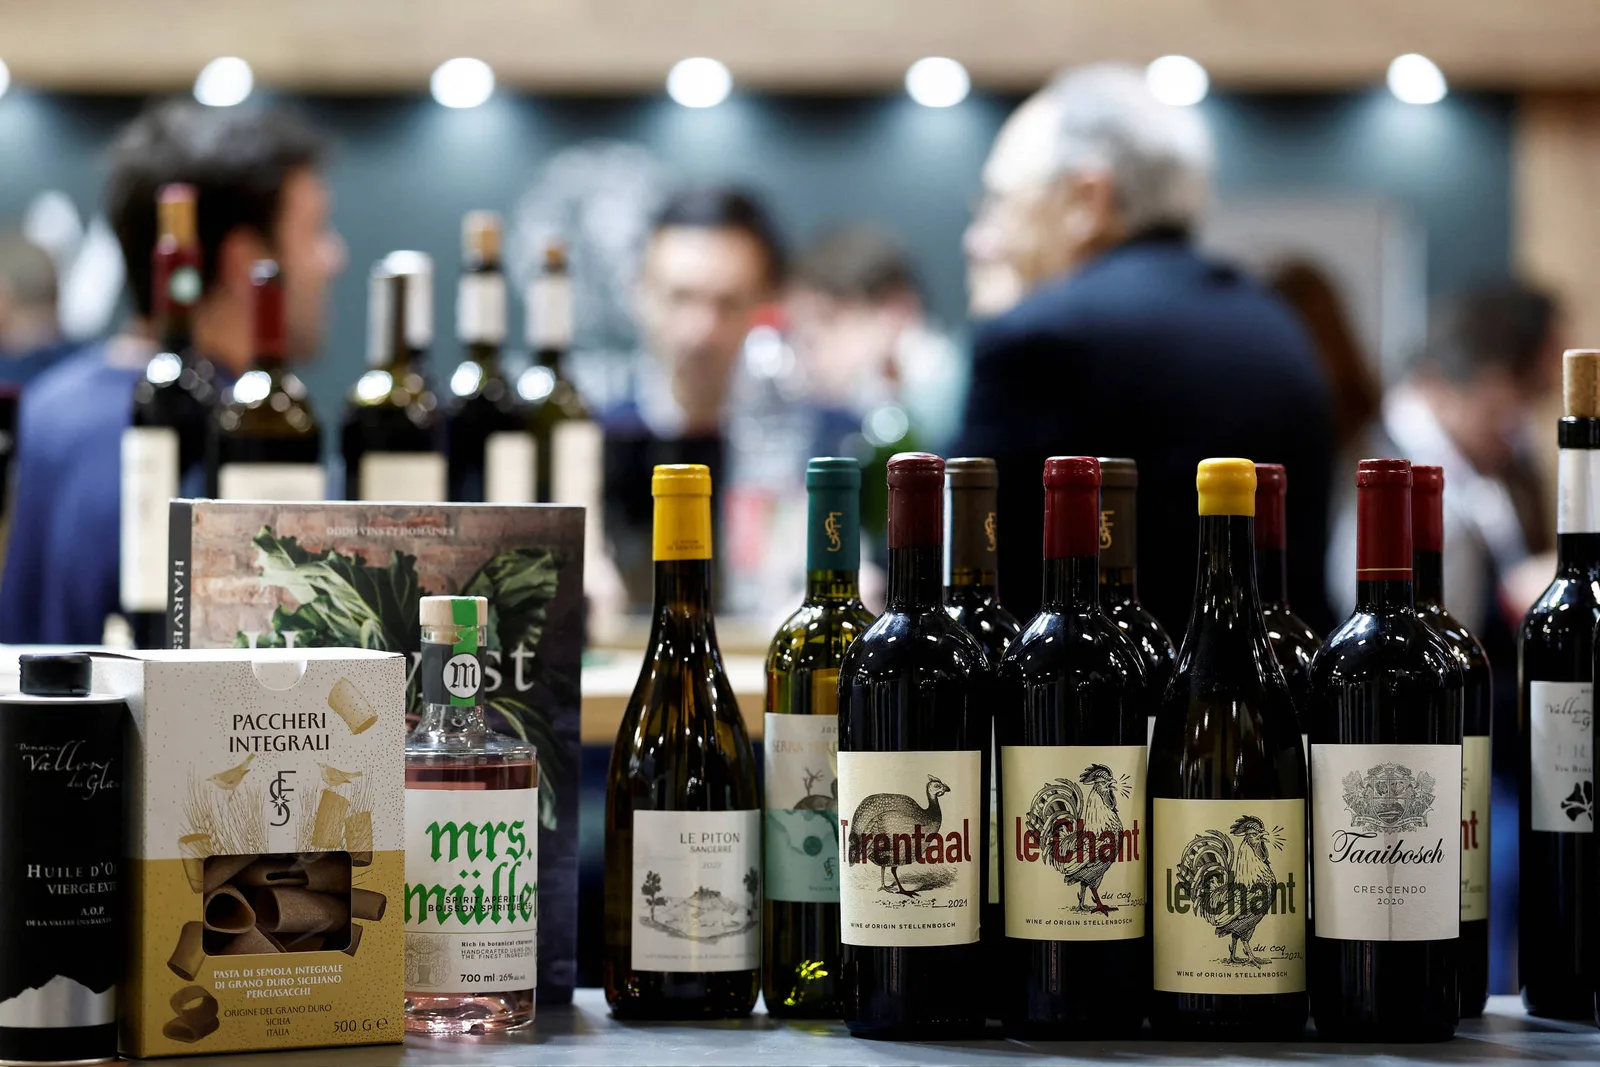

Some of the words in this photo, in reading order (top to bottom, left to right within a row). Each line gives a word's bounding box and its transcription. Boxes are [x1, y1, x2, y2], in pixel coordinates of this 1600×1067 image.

[326, 526, 358, 536] ODDO
[233, 712, 326, 730] PACCHERI
[229, 734, 329, 752] INTEGRALI
[425, 820, 532, 862] mrs.
[680, 833, 696, 844] LE
[701, 832, 741, 843] PITON
[841, 819, 971, 865] Tarentaal
[1015, 817, 1041, 862] le
[1052, 817, 1140, 863] Chant
[690, 845, 732, 854] SANCERRE
[1329, 829, 1445, 865] Taaibosch
[27, 864, 83, 878] HUILE
[47, 883, 96, 895] VIERGE
[1166, 868, 1191, 915] le
[1202, 870, 1296, 915] Chant
[1353, 885, 1427, 894] CRESCENDO
[445, 896, 479, 904] SPIRIT
[1116, 892, 1132, 902] coq
[428, 904, 476, 913] BOISSON
[948, 899, 968, 908] 2021
[1083, 918, 1133, 926] STELLENBOSCH
[1253, 944, 1265, 952] du
[1269, 945, 1286, 956] coq
[213, 970, 240, 979] PASTA
[243, 969, 254, 977] DI
[256, 967, 292, 977] SEMOLA
[295, 964, 344, 974] INTEGRALE
[460, 974, 481, 982] 700
[484, 973, 495, 981] ml
[215, 981, 225, 989] DI
[228, 979, 263, 989] GRANO
[266, 978, 295, 987] DURO
[297, 975, 342, 985] SICILIANO
[246, 987, 311, 998] PERCIASACCHI
[224, 1008, 258, 1018] ORIGINE
[260, 1007, 273, 1015] DEL
[275, 1006, 306, 1015] GRANO
[308, 1004, 332, 1013] DURO
[265, 1018, 291, 1026] SICILIA
[333, 1019, 357, 1033] 500
[362, 1018, 372, 1031] G
[266, 1028, 290, 1037] ITALIA
